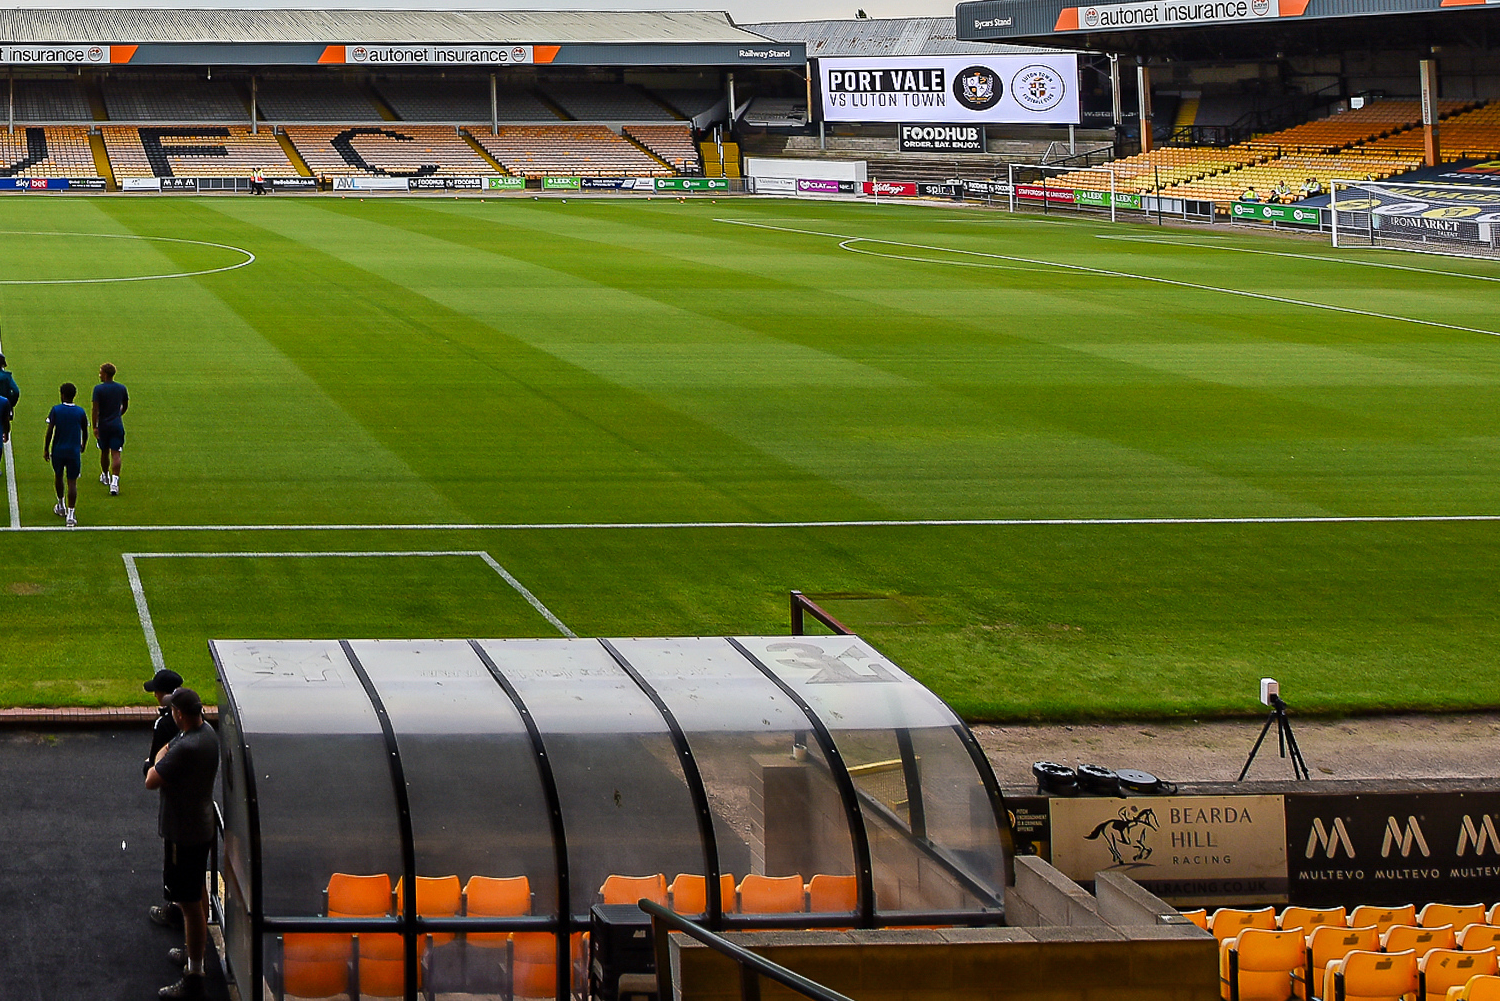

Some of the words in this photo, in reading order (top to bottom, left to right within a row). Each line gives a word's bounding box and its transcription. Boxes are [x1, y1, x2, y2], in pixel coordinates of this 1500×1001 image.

[1100, 4, 1159, 26] autonet
[1163, 0, 1248, 21] insurance
[993, 17, 1011, 27] Stand
[9, 47, 85, 62] insurance
[369, 47, 427, 63] autonet
[432, 46, 508, 63] insurance
[739, 49, 768, 60] Railway
[769, 49, 791, 59] Stand
[830, 71, 883, 91] PORT
[888, 70, 942, 90] VALE
[829, 93, 846, 107] VS
[852, 93, 898, 107] LUTON
[902, 93, 946, 107] TOWN
[902, 126, 979, 141] FOODHUB
[137, 126, 231, 178] F
[330, 127, 440, 177] C
[952, 141, 981, 149] ENJOY.
[15, 178, 29, 188] sky
[31, 179, 46, 187] bet
[1390, 216, 1460, 232] IRONMARKET
[1170, 806, 1253, 824] BEARDA
[1171, 831, 1218, 848] HILL
[1172, 855, 1231, 865] RACING
[1299, 870, 1365, 880] MULTEVO
[1374, 868, 1440, 879] MULTEVO
[1449, 866, 1500, 878] MULTEV
